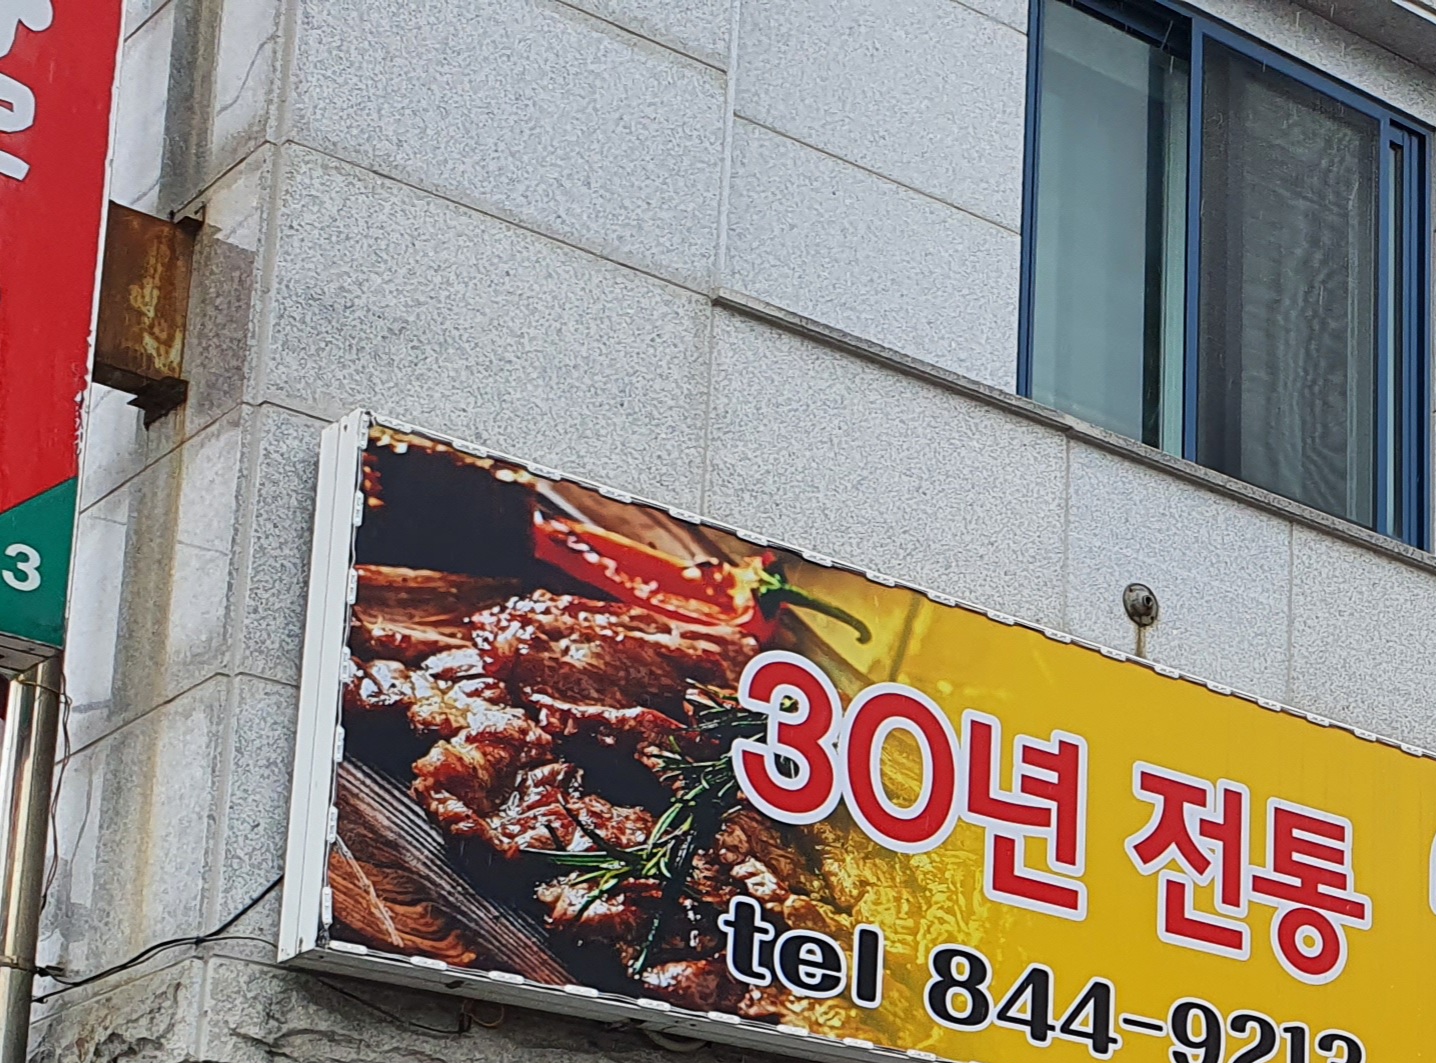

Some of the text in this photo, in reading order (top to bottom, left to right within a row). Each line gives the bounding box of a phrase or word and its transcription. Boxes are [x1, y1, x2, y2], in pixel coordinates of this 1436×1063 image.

[736, 655, 1084, 916] 30년
[1127, 763, 1370, 982] 전통
[721, 898, 882, 1005] tel
